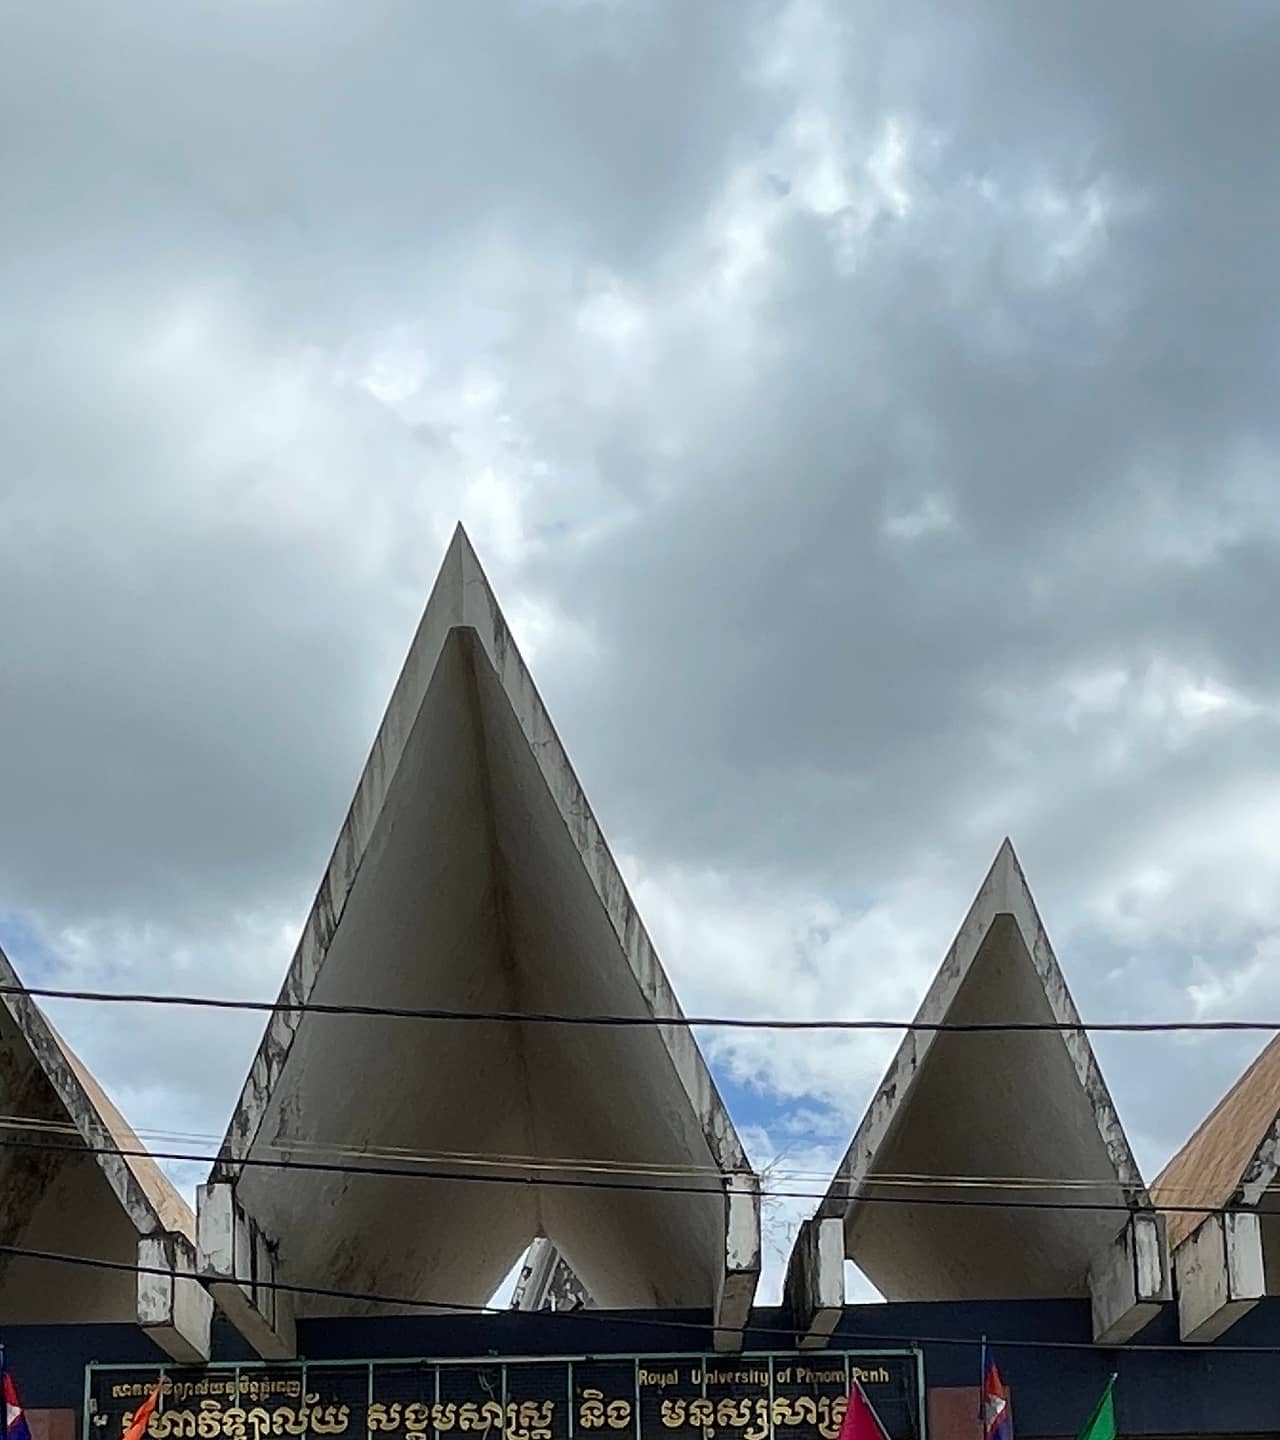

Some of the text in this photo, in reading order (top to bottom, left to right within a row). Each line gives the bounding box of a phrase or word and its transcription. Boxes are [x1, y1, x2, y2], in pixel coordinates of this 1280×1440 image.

[639, 1367, 889, 1387] Royal University of Phnom Penh
[579, 1389, 631, 1428] និង
